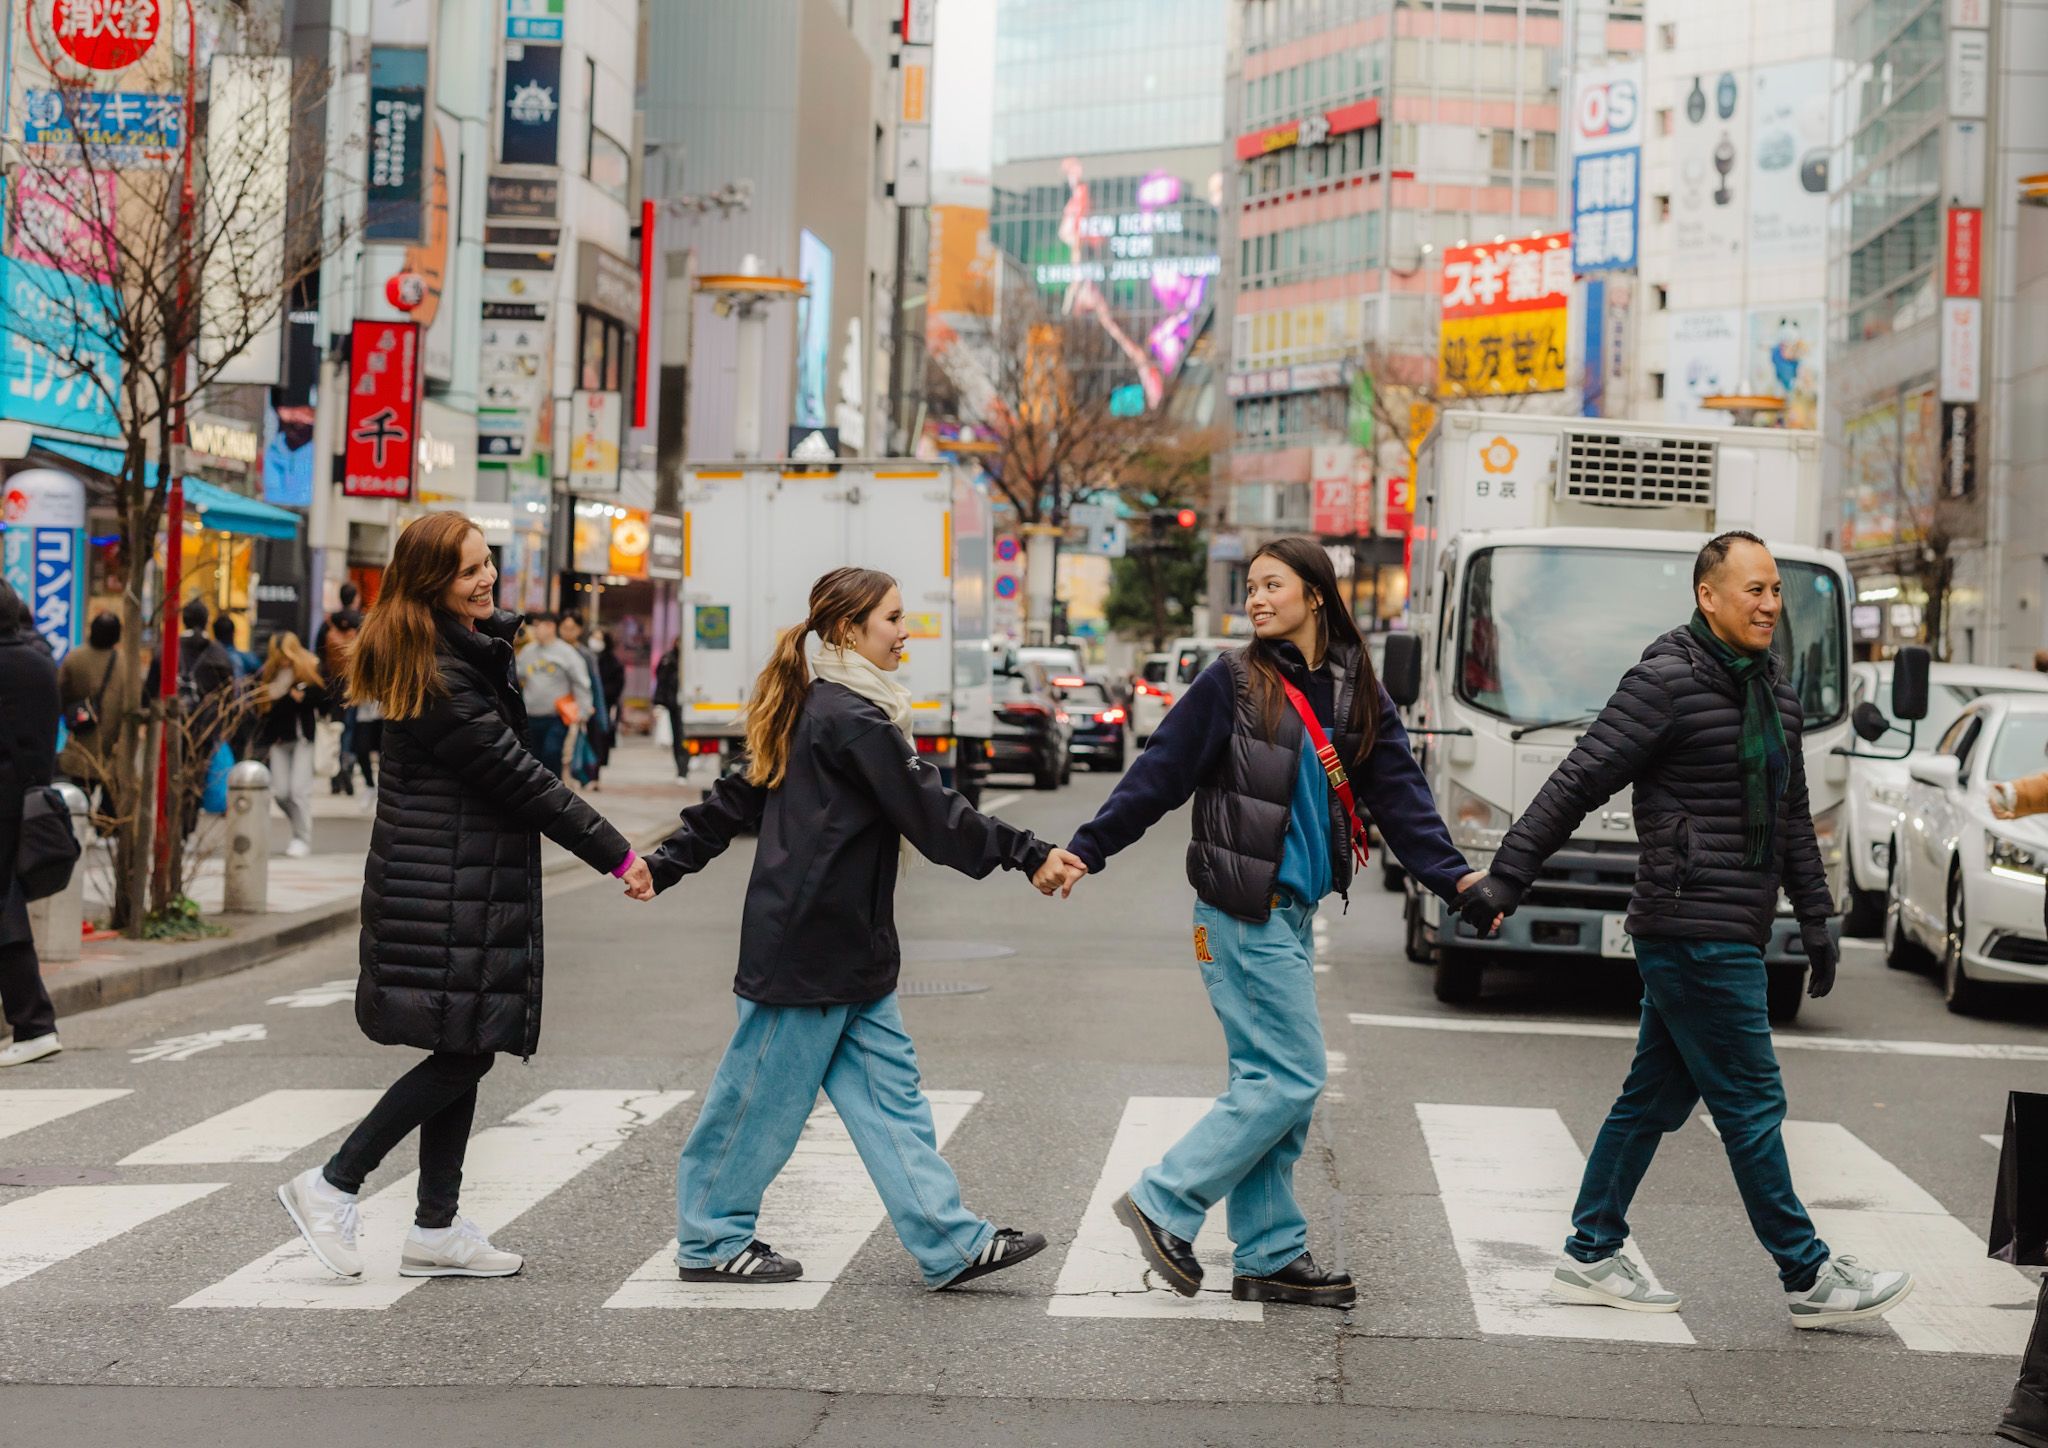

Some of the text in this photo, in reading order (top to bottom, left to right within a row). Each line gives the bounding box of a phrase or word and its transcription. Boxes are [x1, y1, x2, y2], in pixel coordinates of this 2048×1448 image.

[59, 0, 155, 40] 消火栓
[1580, 79, 1637, 138] OS
[1443, 247, 1573, 308] スギ薬局
[1444, 326, 1566, 382] 処方せん
[351, 406, 408, 468] 千
[37, 530, 72, 662] コンタク
[1601, 810, 1631, 830] IS
